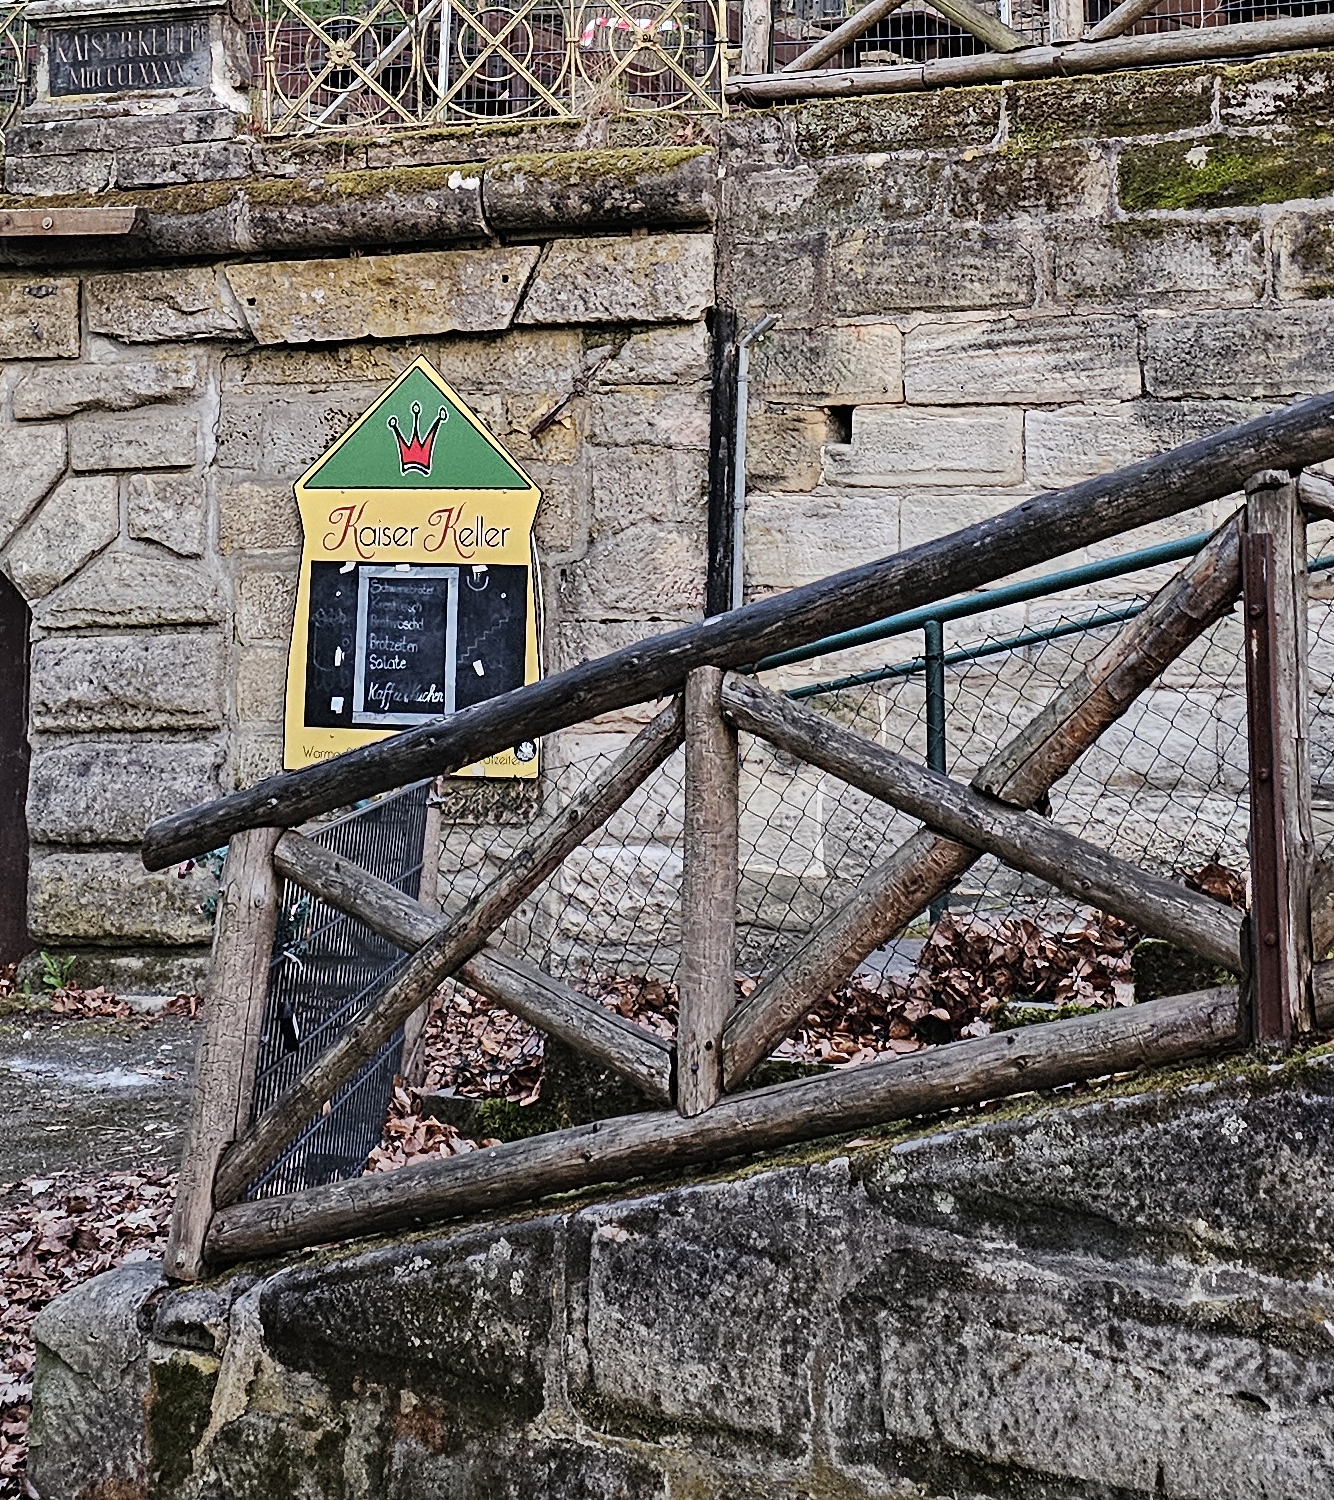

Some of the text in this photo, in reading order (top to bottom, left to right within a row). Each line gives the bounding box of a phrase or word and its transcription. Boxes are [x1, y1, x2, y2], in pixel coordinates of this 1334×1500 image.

[322, 500, 510, 559] Kaiser Keller
[369, 653, 407, 670] Salate
